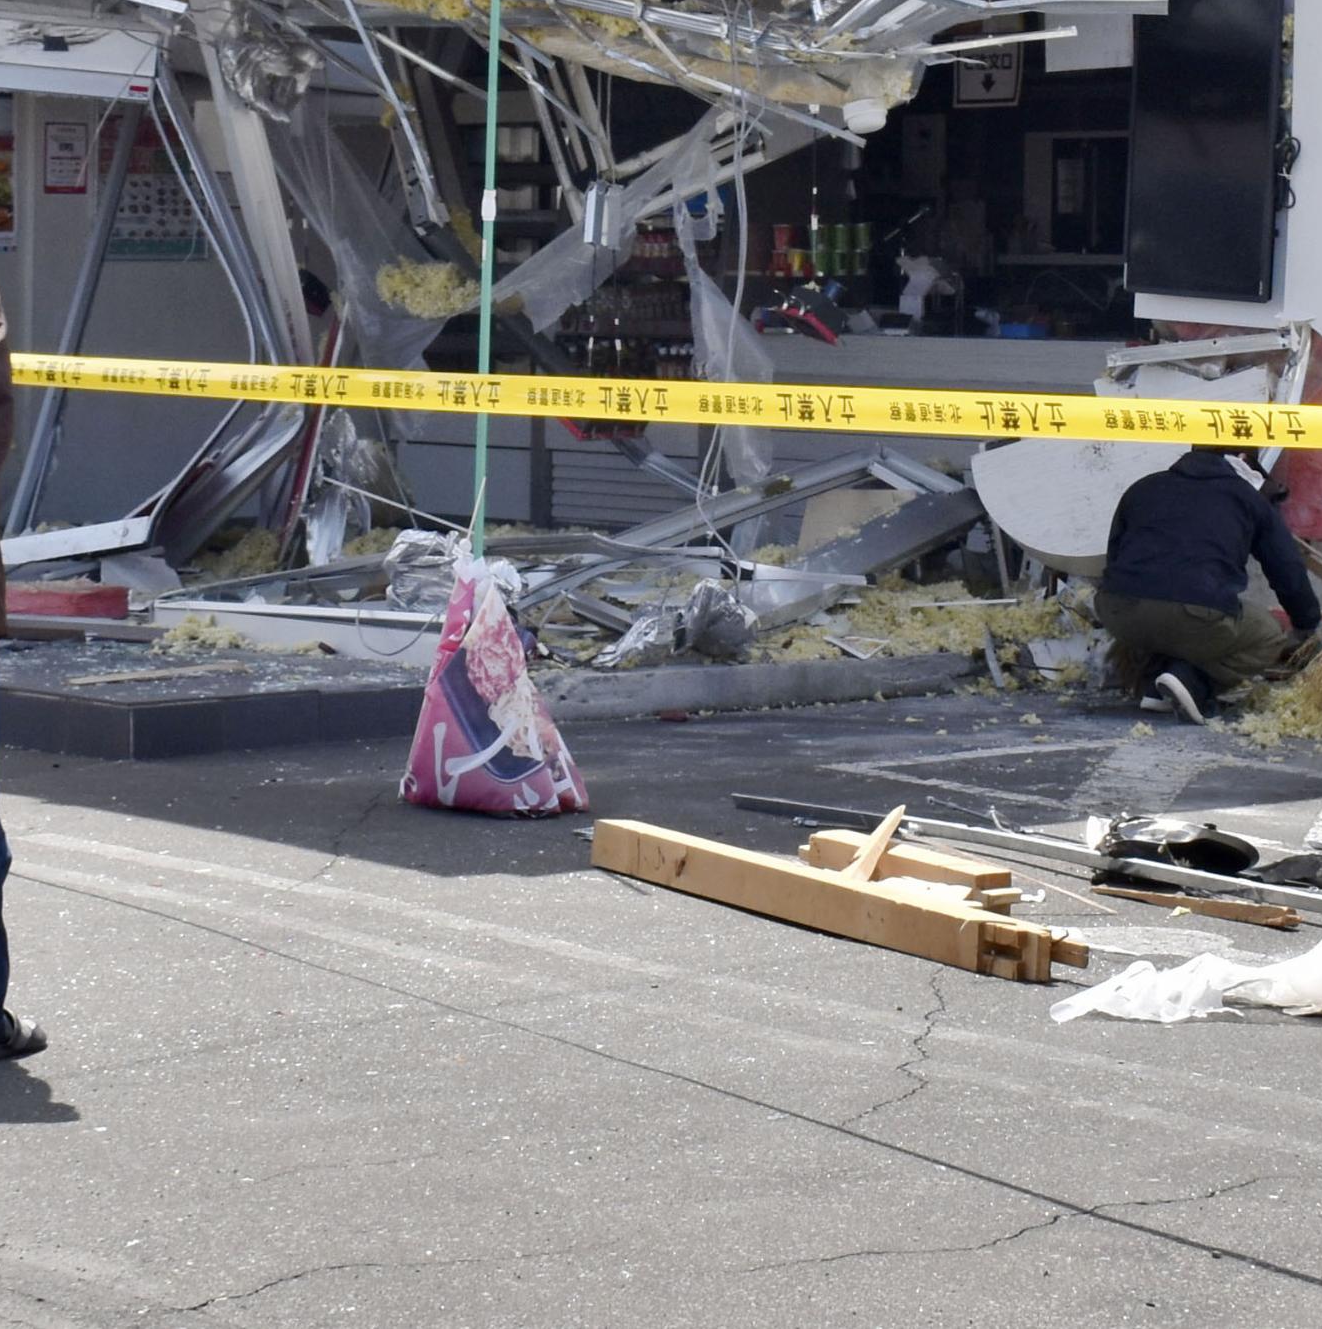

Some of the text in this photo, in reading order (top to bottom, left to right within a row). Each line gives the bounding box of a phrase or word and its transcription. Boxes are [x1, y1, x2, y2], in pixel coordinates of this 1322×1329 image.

[155, 367, 211, 392] 立入禁止
[289, 373, 350, 400] 立入禁止
[436, 379, 502, 408] 立入禁止
[527, 386, 585, 407] 北海道警察
[598, 384, 669, 415] 立入禁止
[698, 394, 764, 415] 北海道警察
[776, 392, 856, 424] 立入禁止
[889, 403, 963, 424] 北海道警察
[975, 401, 1067, 433] 立入禁止
[1105, 408, 1187, 432] 北海道警察
[1201, 409, 1306, 442] 立入禁止
